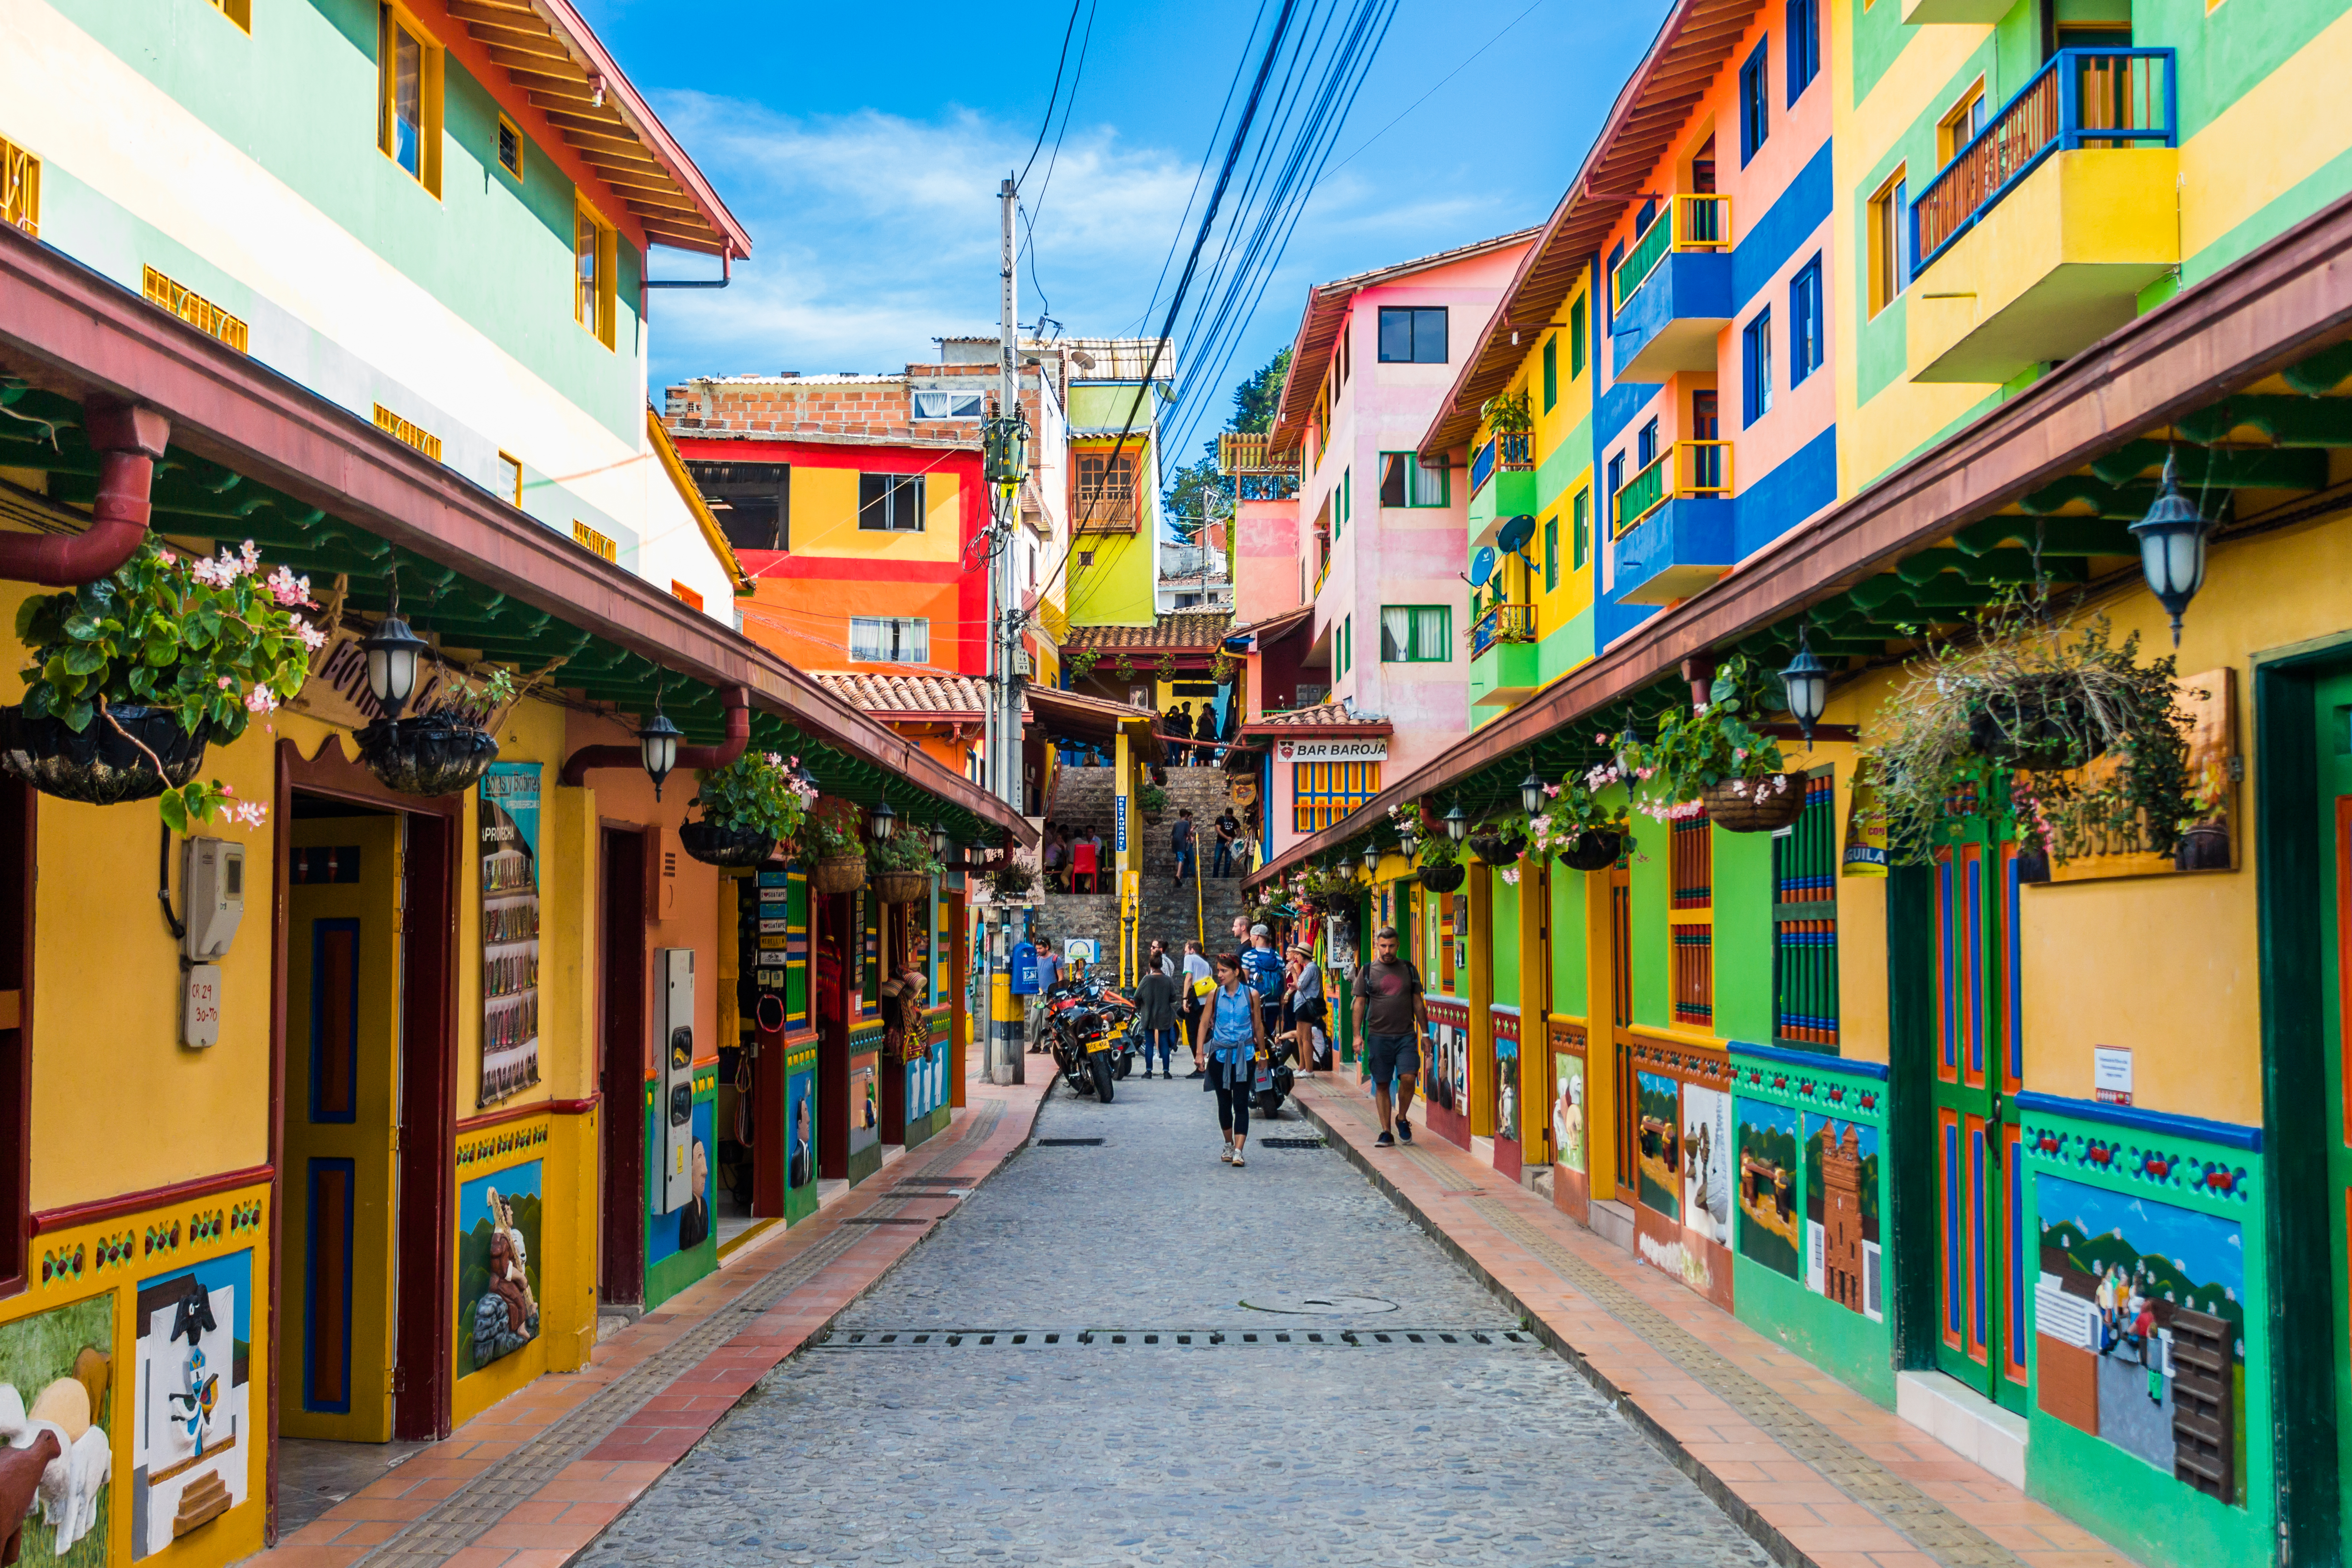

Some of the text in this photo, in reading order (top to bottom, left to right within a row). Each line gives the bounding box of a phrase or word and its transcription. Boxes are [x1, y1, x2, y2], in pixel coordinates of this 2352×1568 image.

[1297, 744, 1386, 756] BAR BAROJA
[485, 771, 506, 792] Botas
[514, 771, 540, 793] Botines
[192, 983, 211, 1001] CR 29
